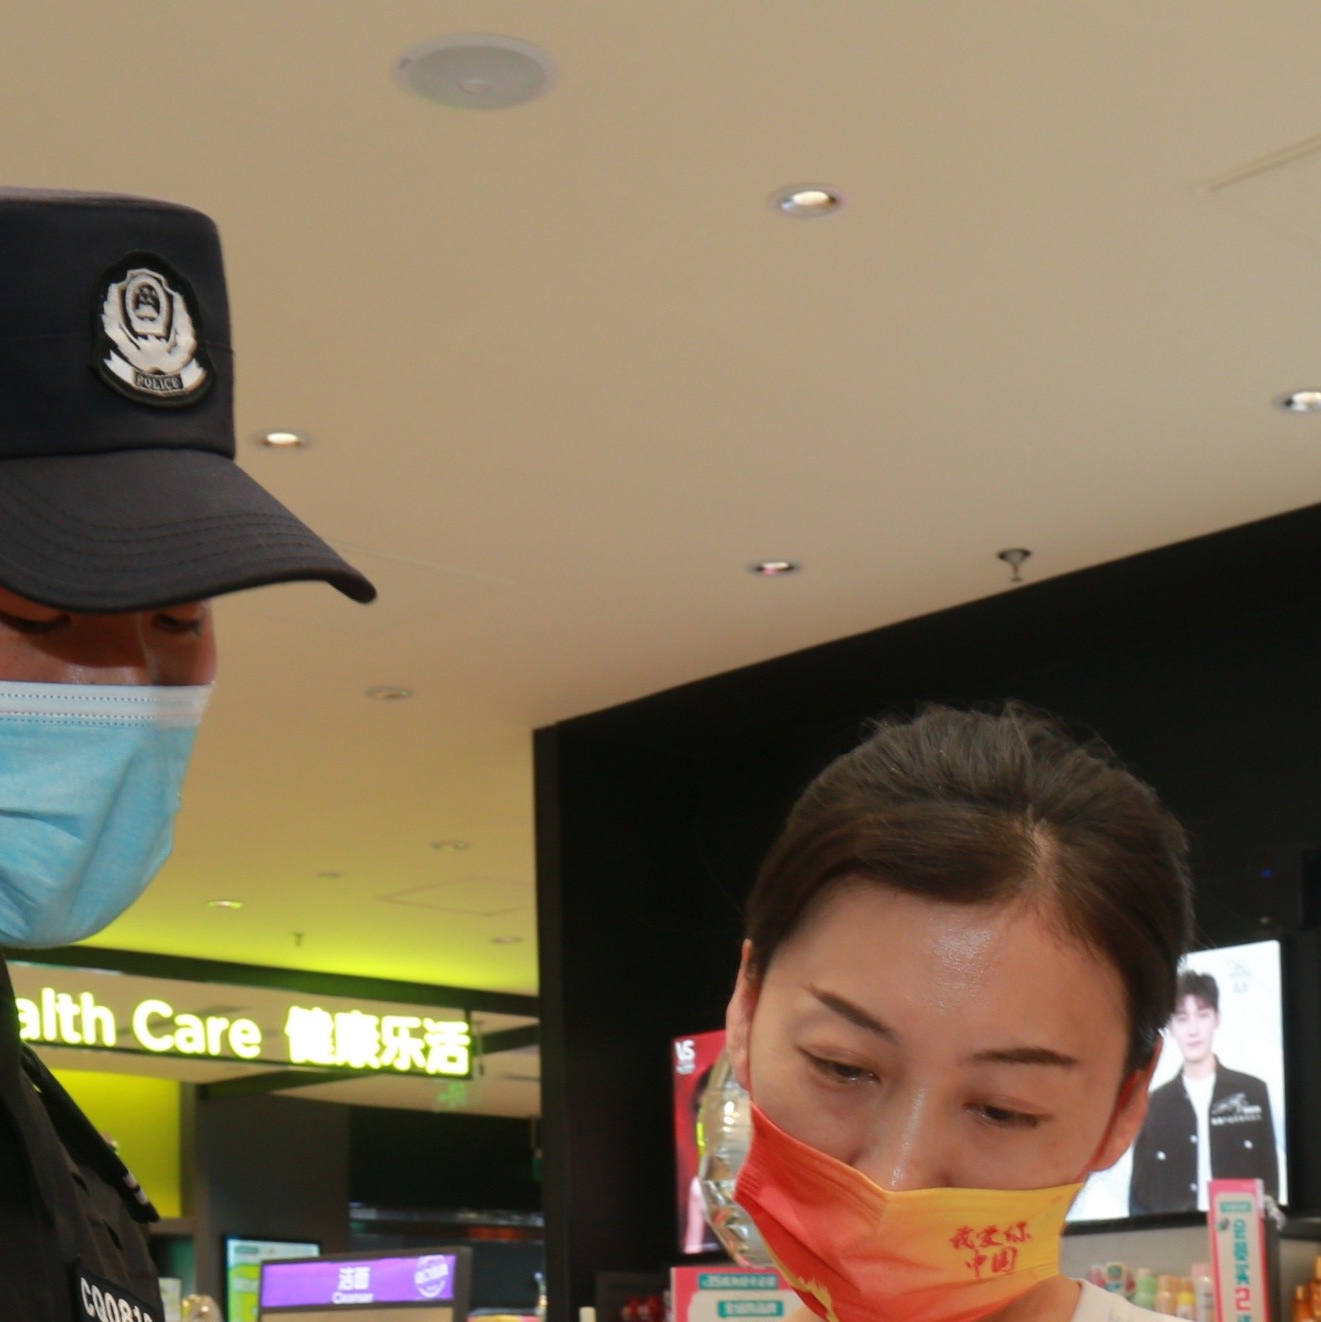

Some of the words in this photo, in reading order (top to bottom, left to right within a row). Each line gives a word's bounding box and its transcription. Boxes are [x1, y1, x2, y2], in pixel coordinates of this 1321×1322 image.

[136, 374, 181, 391] POLICE
[16, 987, 116, 1047] alth
[133, 999, 262, 1059] Care
[285, 1006, 471, 1075] 健康乐活
[966, 1247, 1018, 1278] 中国
